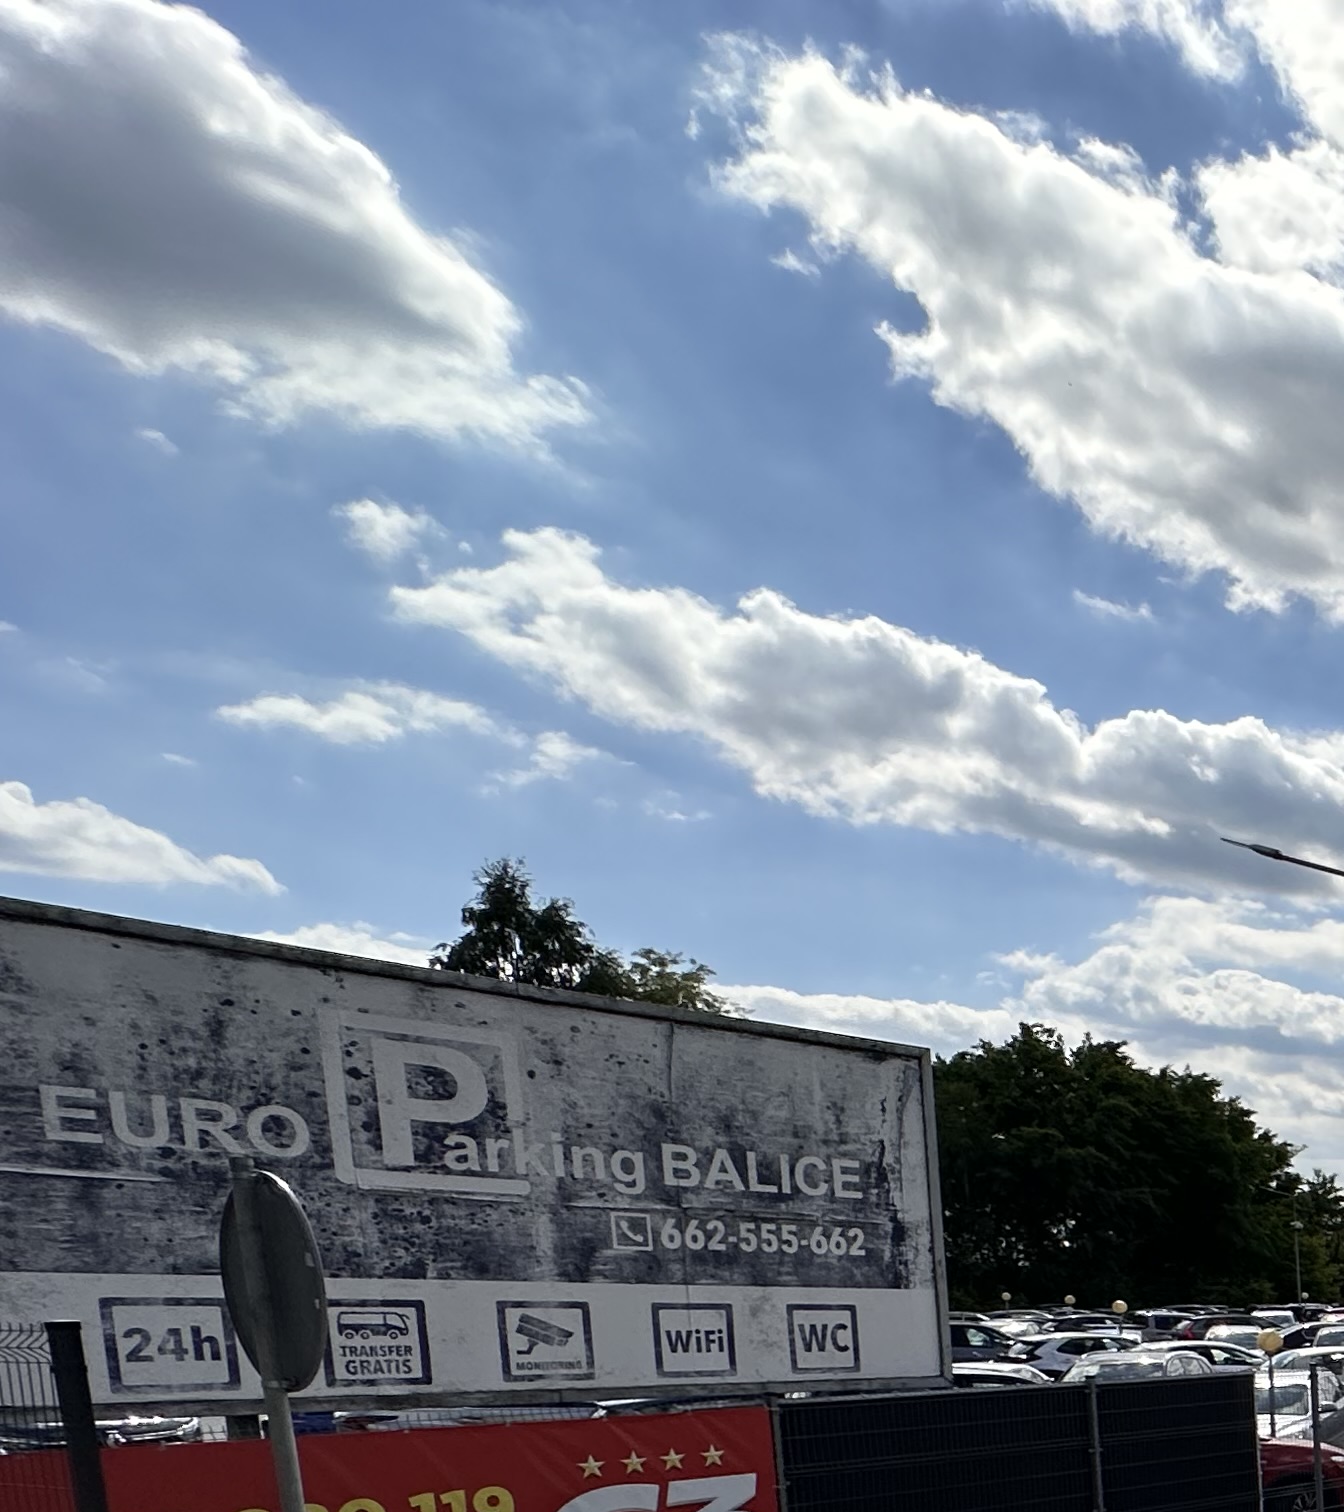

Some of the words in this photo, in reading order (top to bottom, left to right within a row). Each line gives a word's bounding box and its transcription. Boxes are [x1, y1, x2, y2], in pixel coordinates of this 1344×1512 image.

[38, 1084, 310, 1157] EURO
[371, 1036, 646, 1195] Parking
[661, 1143, 863, 1199] BALICE
[660, 1218, 866, 1256] 662-555-662
[122, 1325, 222, 1362] 24h
[339, 1345, 413, 1357] TRANSFER
[665, 1329, 724, 1353] WiFi
[798, 1323, 850, 1352] WC
[345, 1359, 412, 1375] GRATIS
